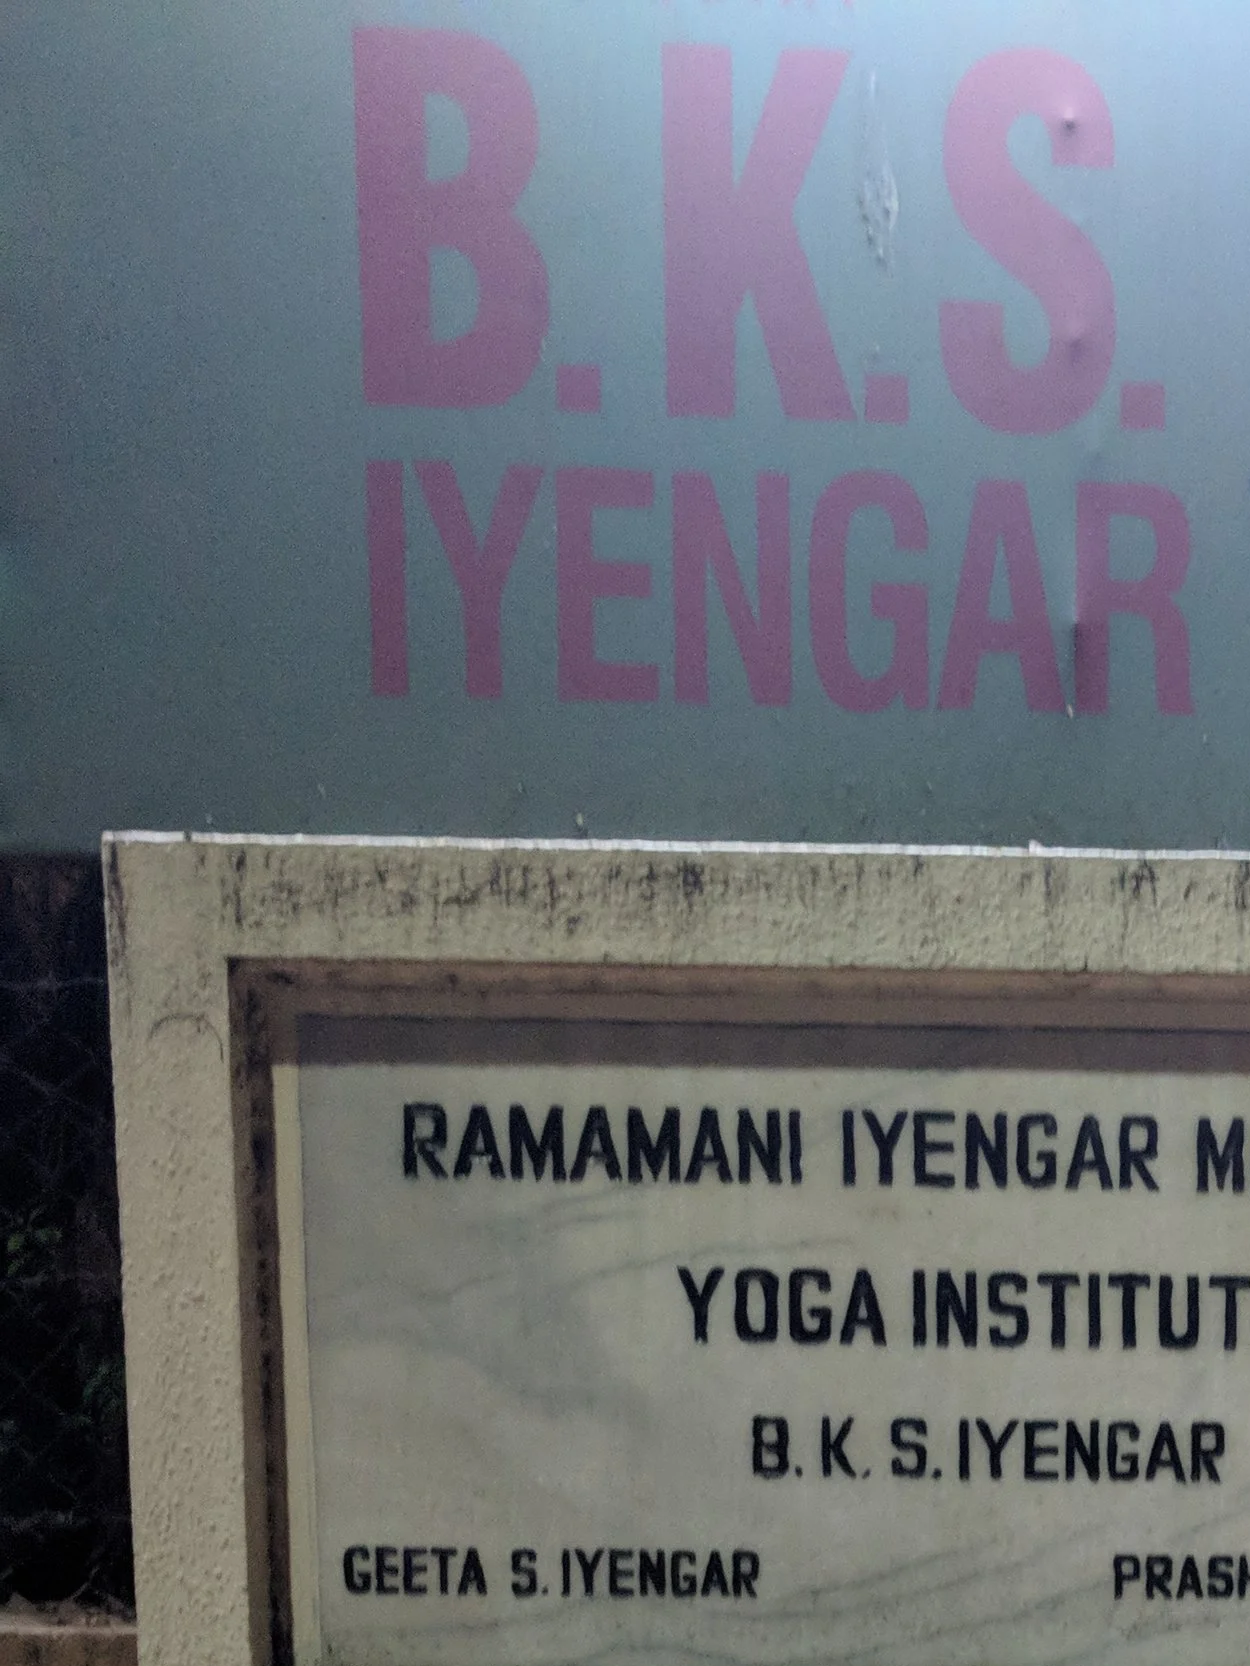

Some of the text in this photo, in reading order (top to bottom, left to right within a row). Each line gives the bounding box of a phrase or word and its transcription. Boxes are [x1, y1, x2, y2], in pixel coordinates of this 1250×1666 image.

[365, 460, 1195, 717] IYENGAR
[402, 1102, 803, 1185] RAMAMANI
[842, 1109, 1159, 1191] IYENGAR
[677, 1266, 887, 1347] YOGA
[342, 1546, 488, 1596] GEETA
